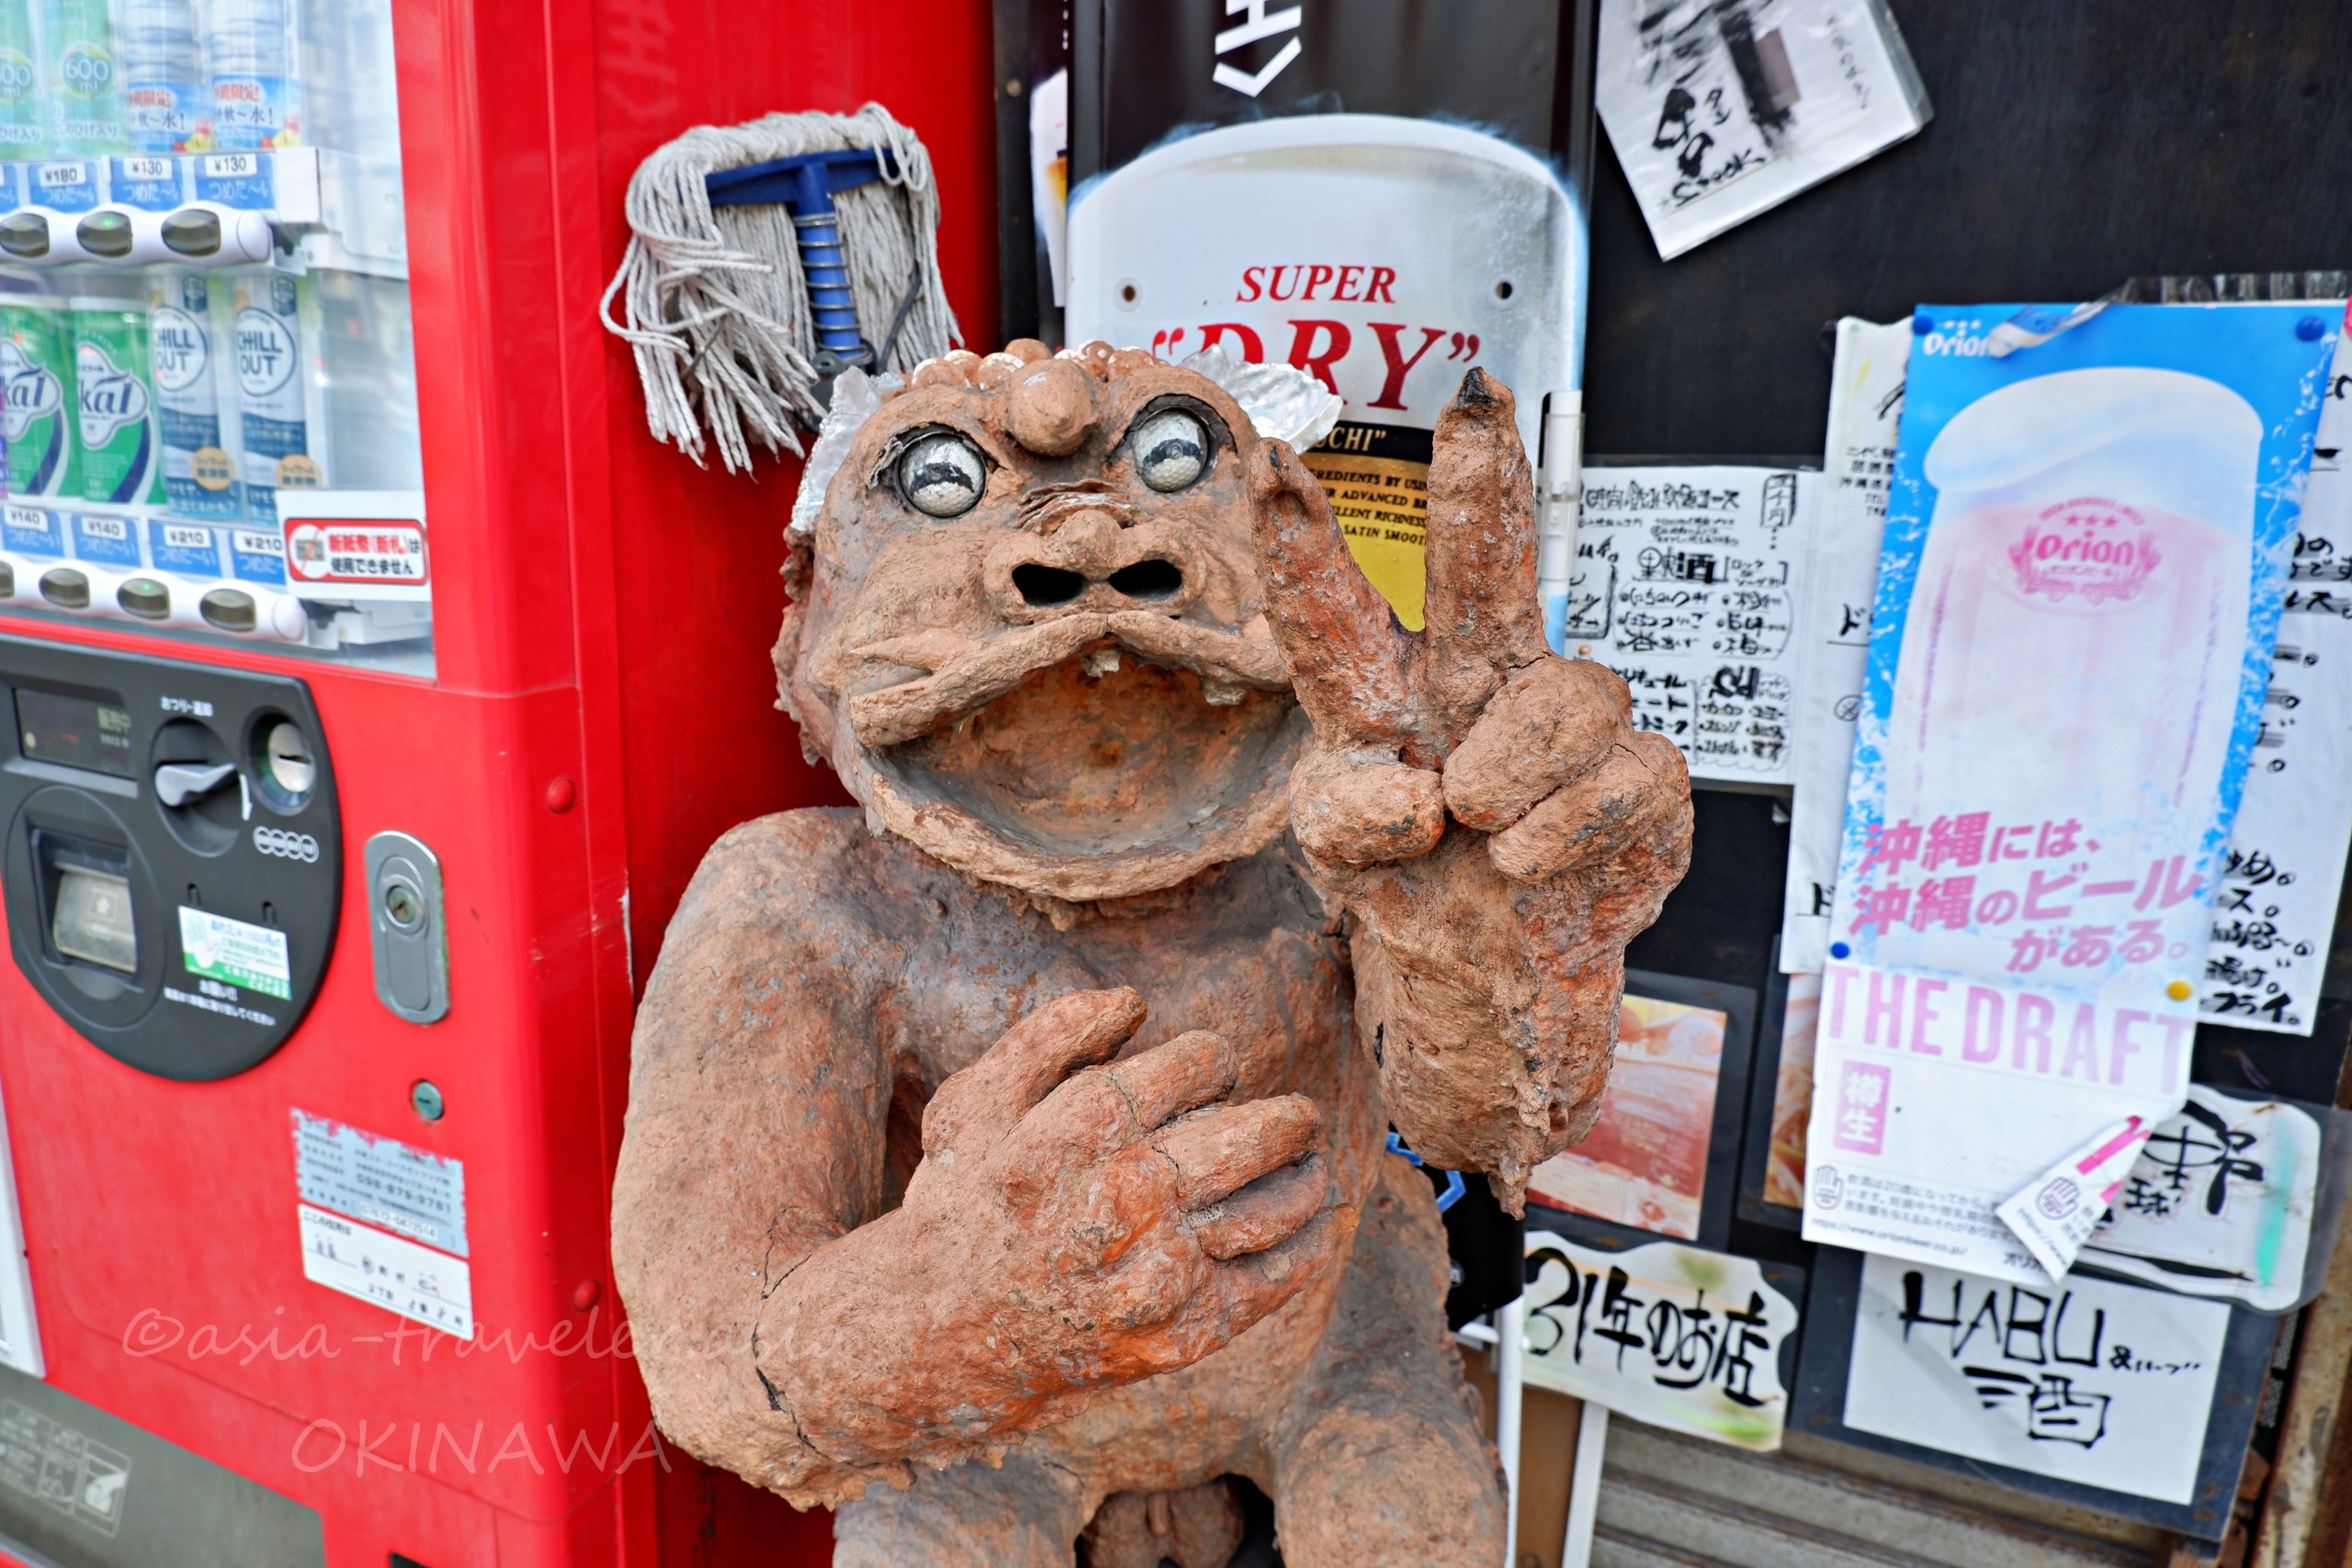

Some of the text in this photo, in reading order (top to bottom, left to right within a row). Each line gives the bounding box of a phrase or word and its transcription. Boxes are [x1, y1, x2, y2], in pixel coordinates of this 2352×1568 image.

[0, 64, 31, 86] 00
[66, 58, 109, 81] 600
[46, 167, 78, 183] ¥180
[131, 160, 164, 175] ¥130
[214, 156, 247, 173] ¥130
[1236, 265, 1396, 304] SUPER
[1923, 330, 1991, 357] Orio
[240, 354, 278, 377] OUT
[1385, 476, 1402, 488] BY
[1341, 490, 1408, 506] ADVANCED
[11, 508, 40, 525] ¥140
[87, 520, 120, 536] ¥140
[169, 529, 205, 545] ¥210
[1344, 525, 1380, 537] SATIN
[243, 535, 283, 551] ¥210
[2035, 529, 2134, 566] Orion
[331, 558, 413, 575] 使用できません
[1858, 811, 2101, 876] 沖縄には、
[1849, 855, 2205, 936] 沖縄のビール
[2006, 919, 2189, 974] がある。
[1825, 964, 2196, 1096] THE DRAFT
[1898, 1270, 2107, 1369] HABU
[1962, 1365, 2112, 1450] 酒
